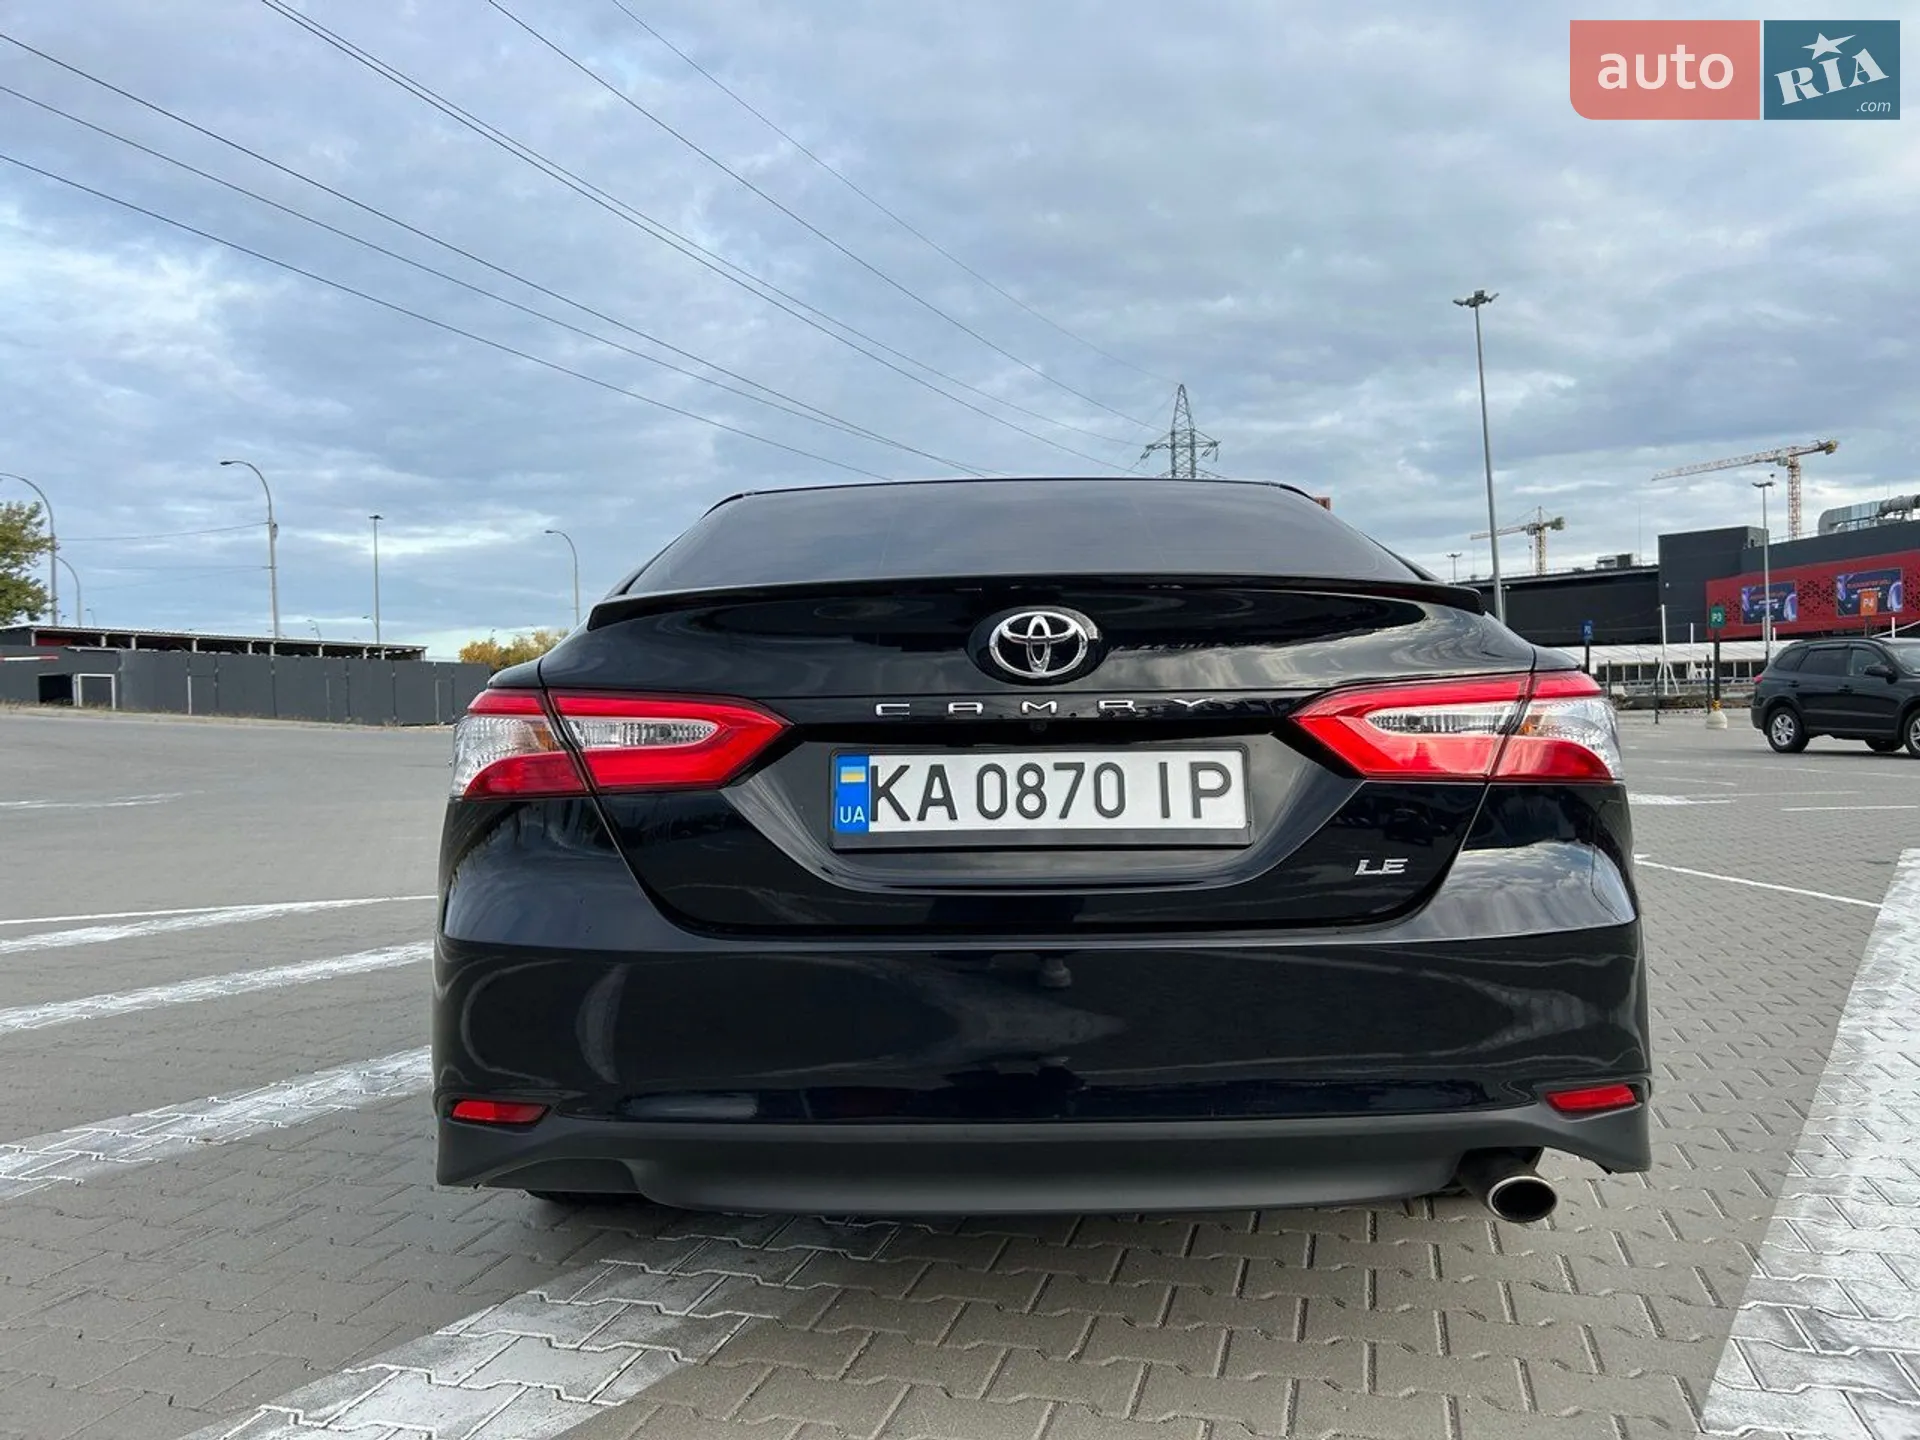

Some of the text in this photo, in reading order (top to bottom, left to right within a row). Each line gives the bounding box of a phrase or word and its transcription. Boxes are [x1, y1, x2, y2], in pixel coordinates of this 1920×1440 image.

[874, 697, 1214, 717] CAMRY
[869, 761, 1233, 822] KA 0870 IP
[839, 806, 865, 824] UA
[1354, 858, 1408, 876] LE
